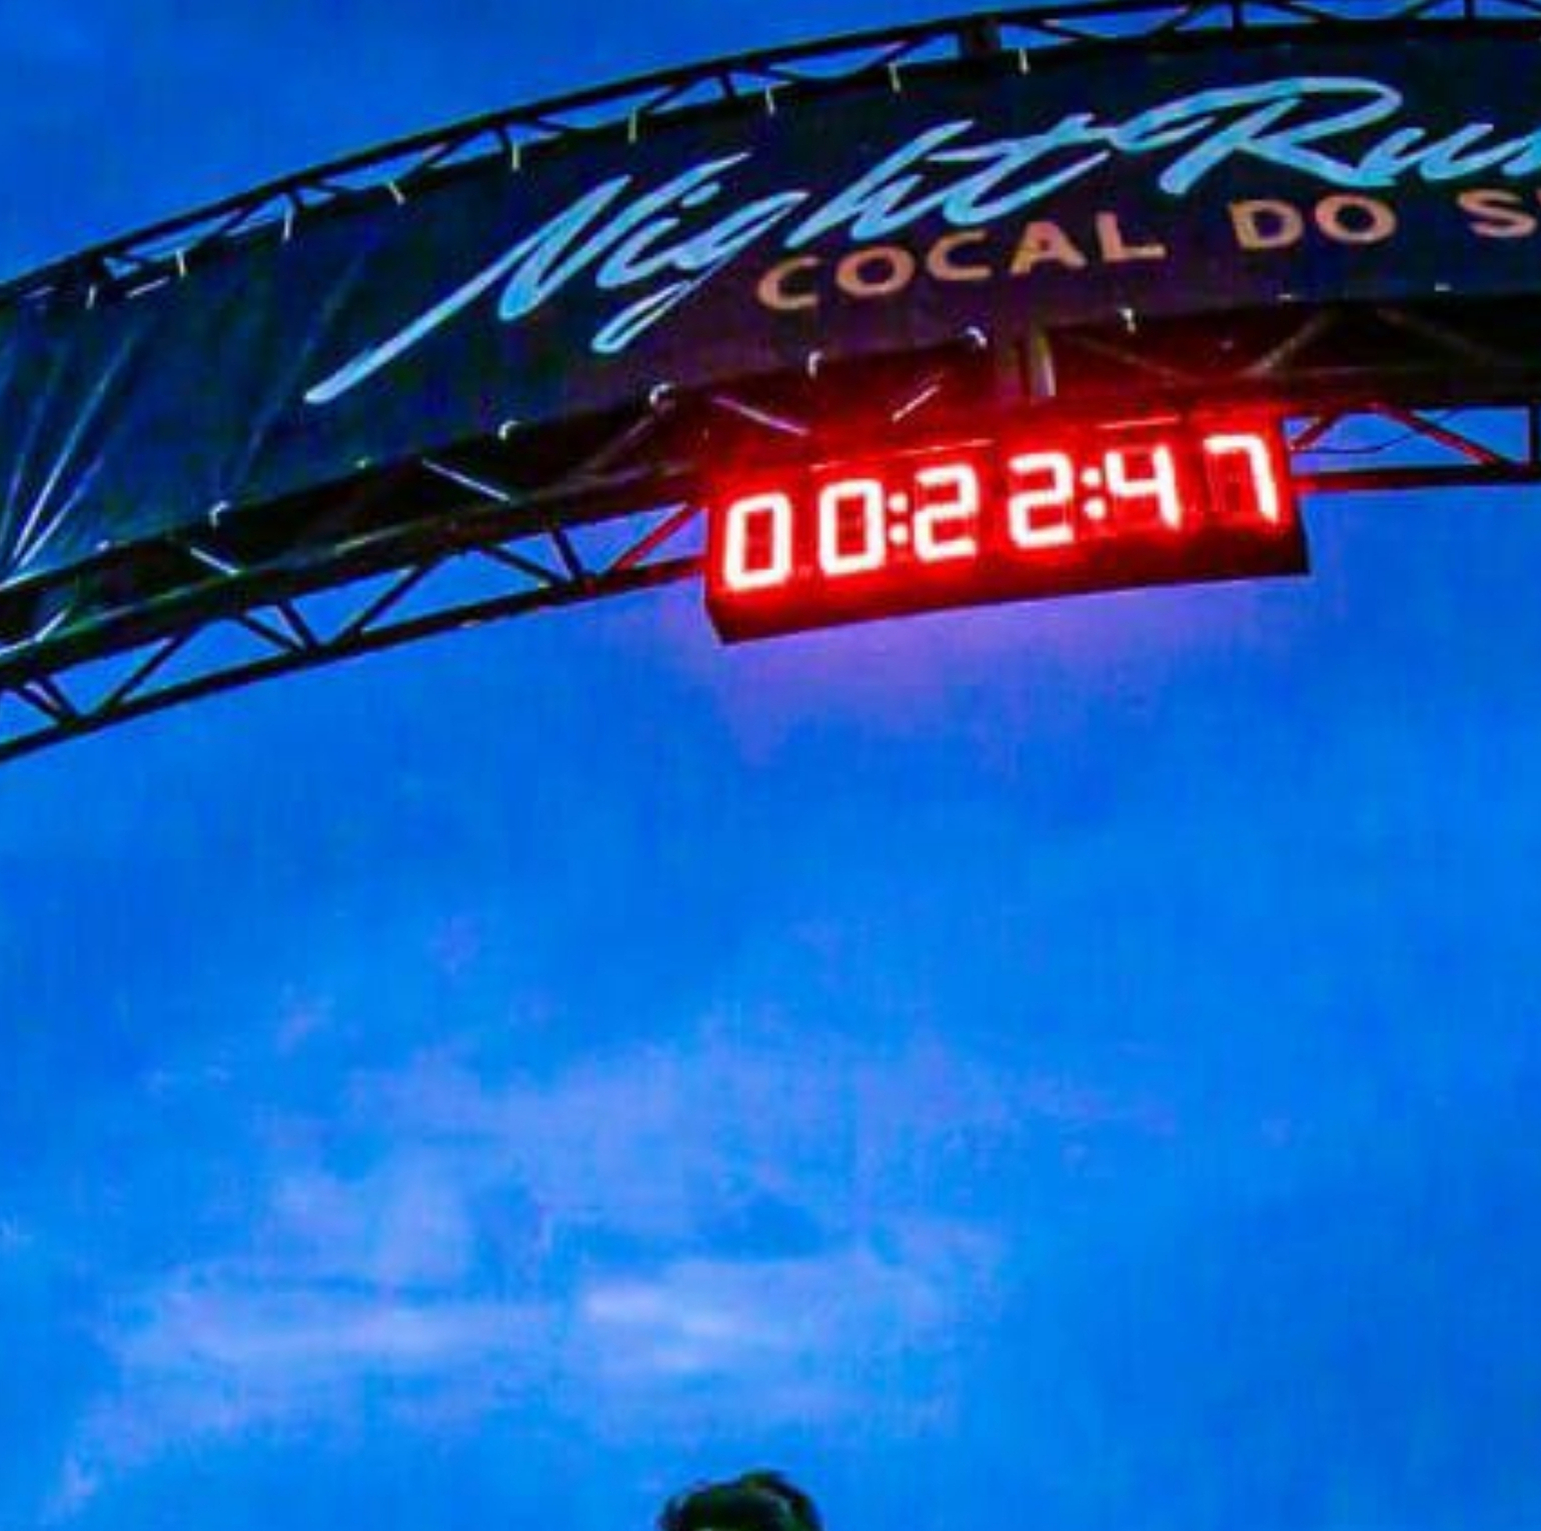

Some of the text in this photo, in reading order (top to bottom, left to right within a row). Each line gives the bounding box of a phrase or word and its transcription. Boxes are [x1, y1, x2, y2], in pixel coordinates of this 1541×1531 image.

[303, 112, 1113, 402] Night
[757, 209, 1167, 311] COCAL
[1227, 192, 1399, 250] DO
